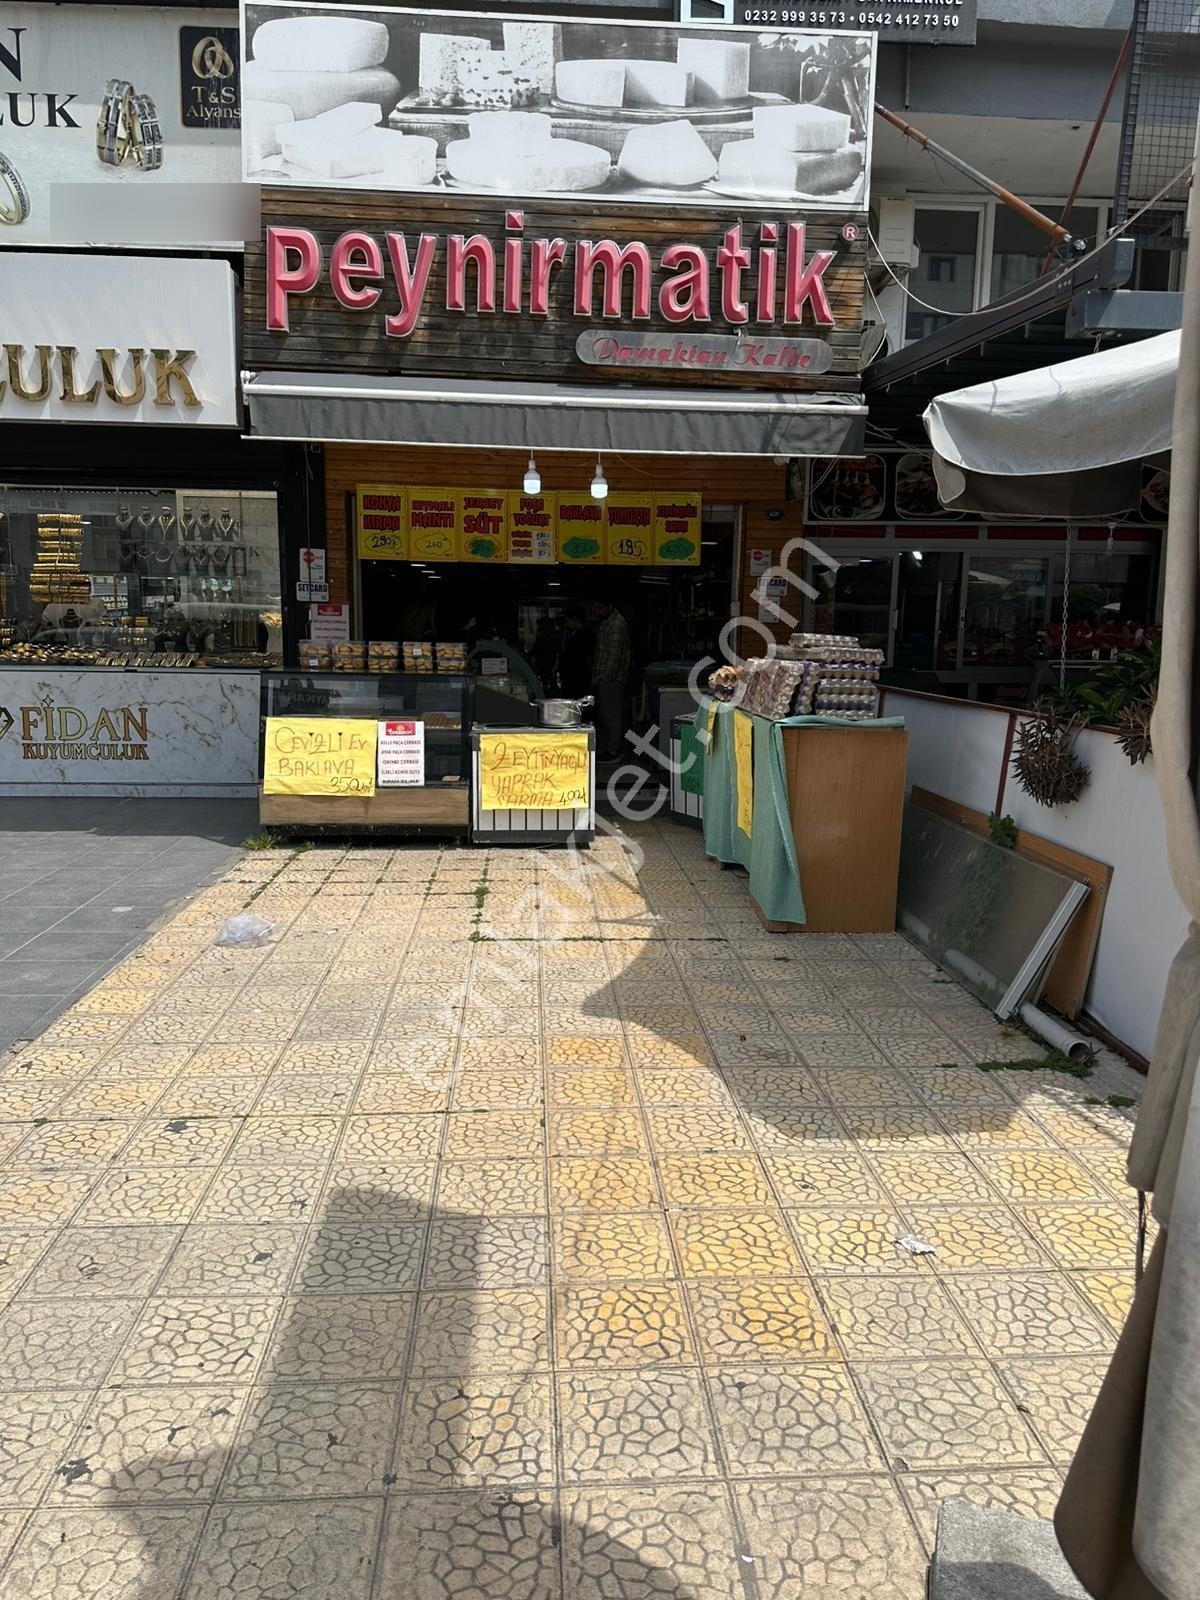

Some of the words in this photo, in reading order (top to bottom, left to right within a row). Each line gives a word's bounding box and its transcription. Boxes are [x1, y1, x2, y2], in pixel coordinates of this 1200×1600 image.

[744, 10, 777, 22] 0232
[781, 11, 806, 23] 999
[810, 11, 827, 23] 35
[830, 12, 846, 24] 73
[859, 13, 892, 25] 0542
[895, 14, 920, 26] 412
[924, 14, 940, 26] 73
[943, 15, 960, 27] 50
[0, 92, 82, 128] UK
[187, 104, 241, 120] Alyans
[591, 336, 729, 366] Damaktan
[735, 343, 811, 368] Kalbe
[0, 343, 204, 409] ULUK
[464, 497, 504, 511] JERSEY
[464, 512, 504, 535] SÜT
[20, 695, 149, 741] FİDAN
[277, 757, 355, 777] BAKLAVA
